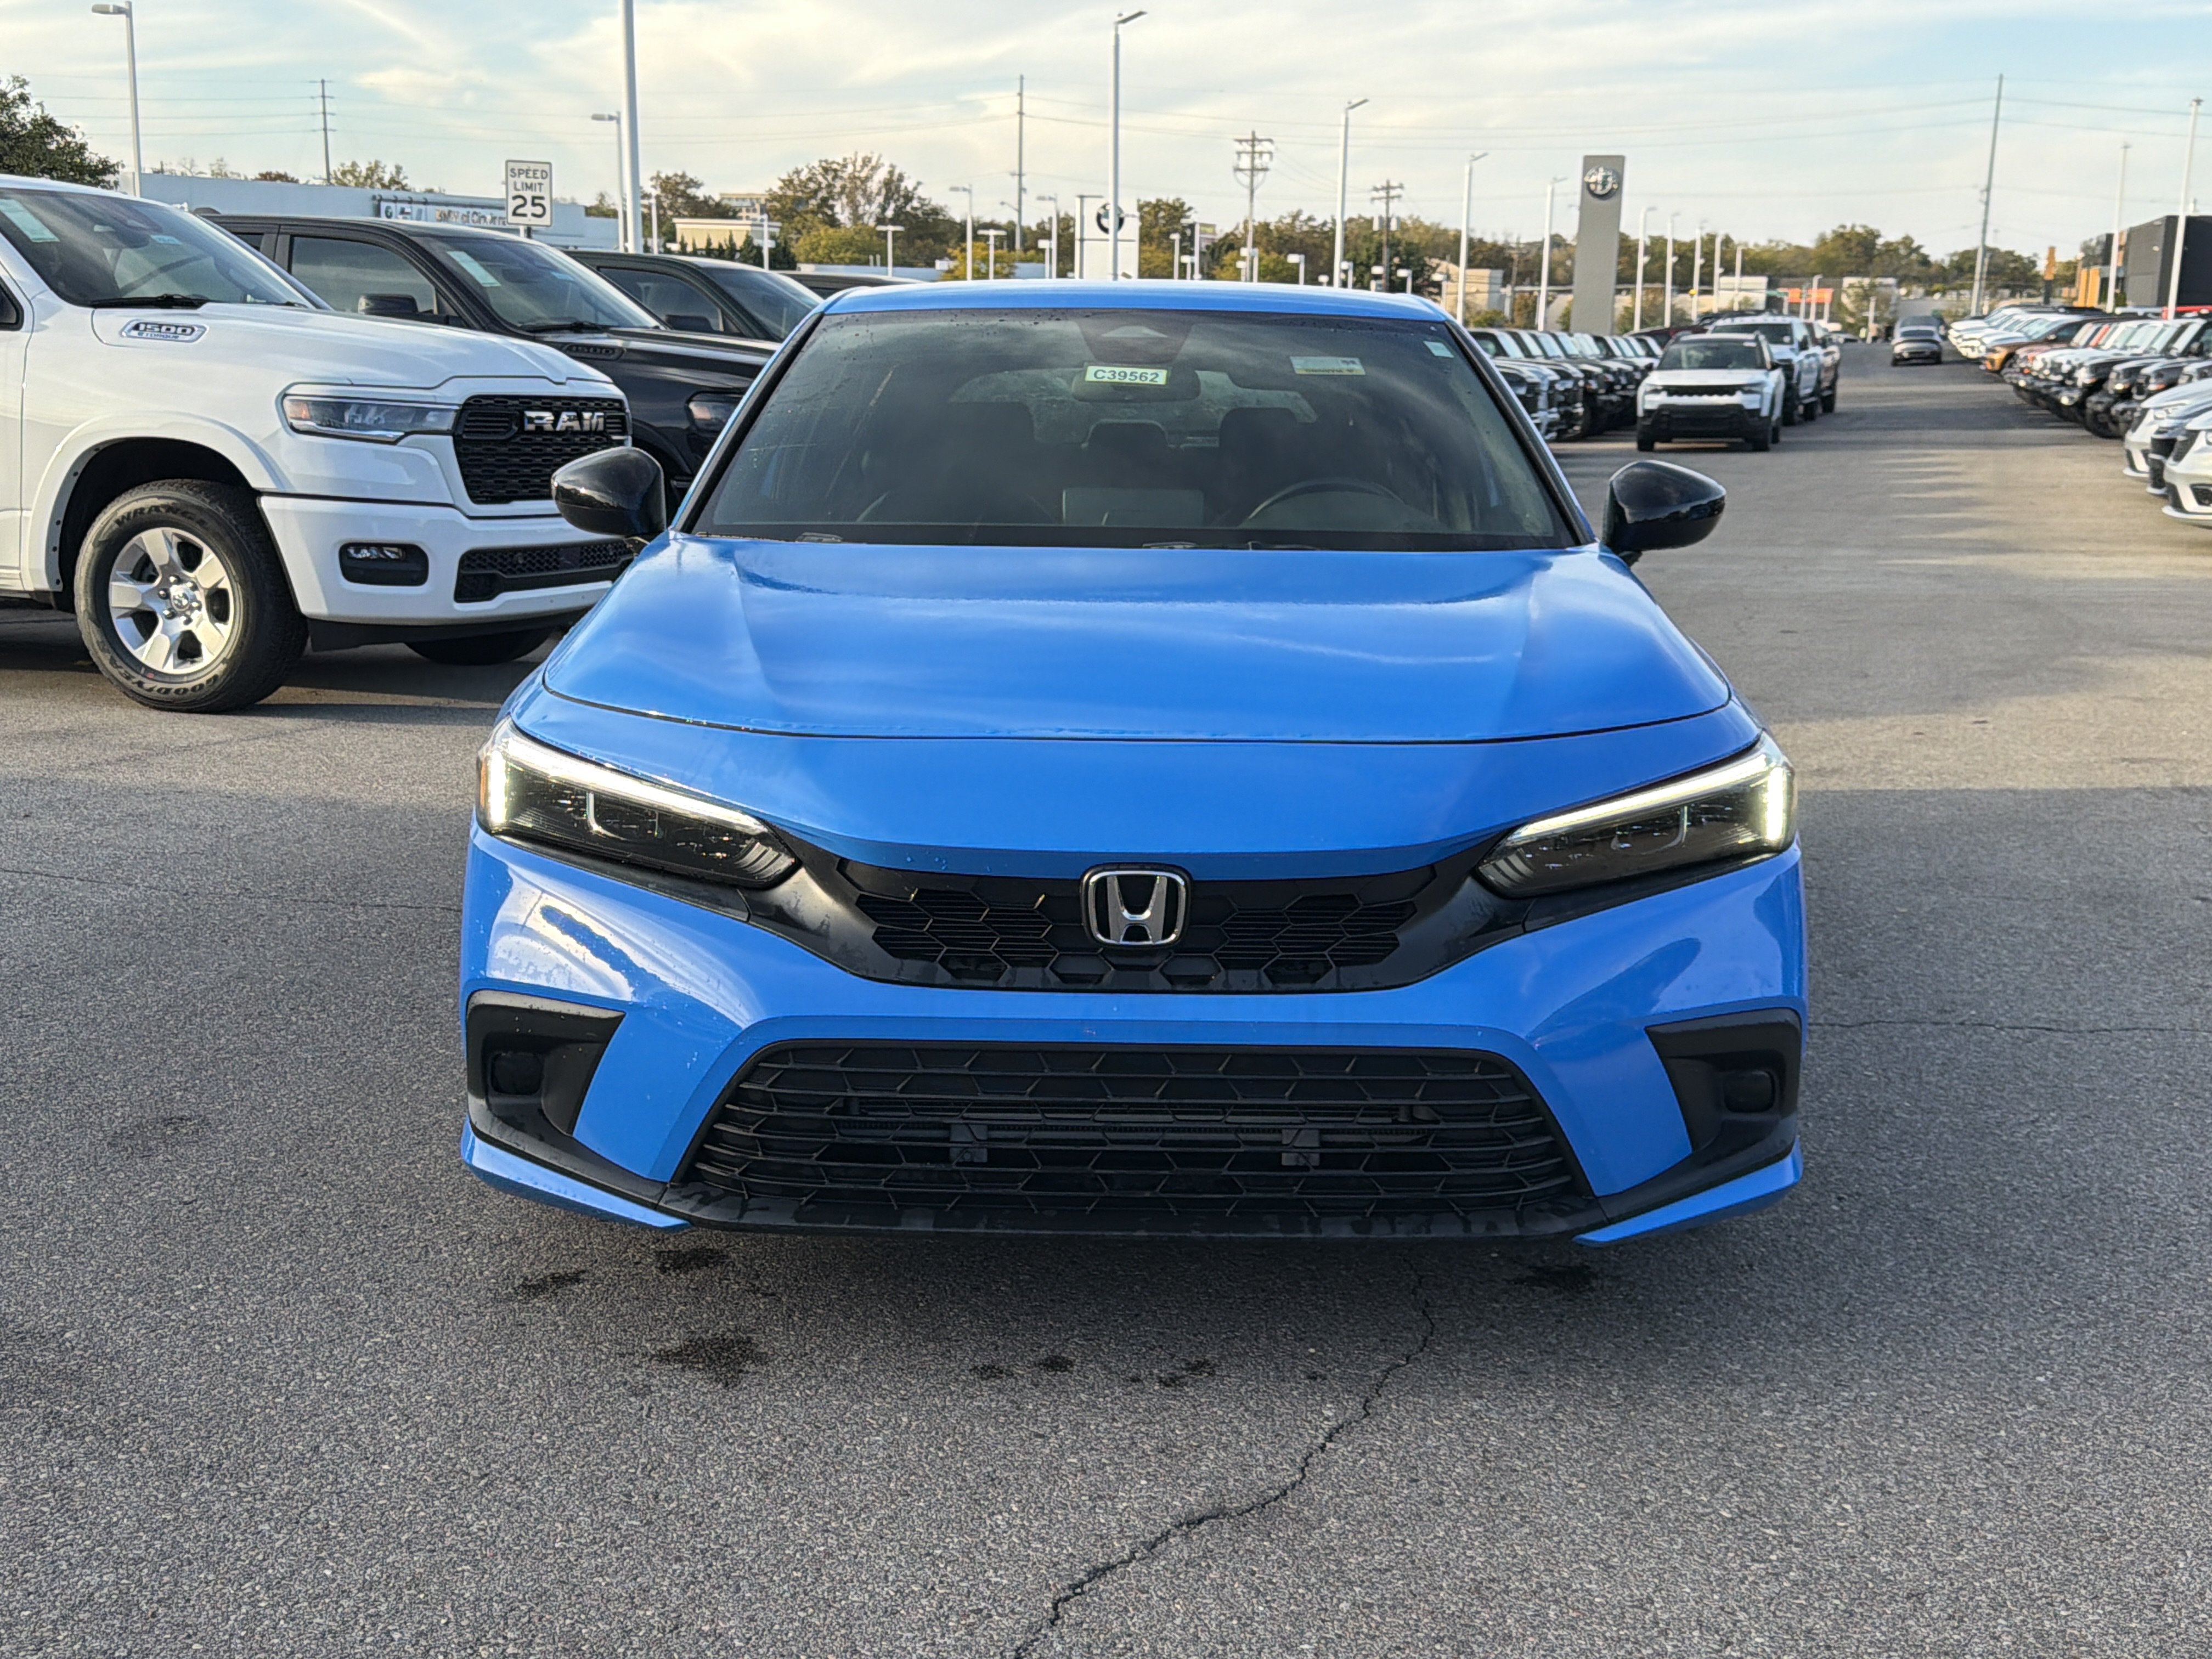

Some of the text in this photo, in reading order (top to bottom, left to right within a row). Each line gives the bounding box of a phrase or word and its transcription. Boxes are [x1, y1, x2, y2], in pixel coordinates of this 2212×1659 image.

[510, 168, 548, 179] SPEED
[514, 181, 544, 193] LIMIT
[512, 195, 546, 218] 25
[139, 323, 192, 334] 1500
[1093, 369, 1159, 383] C39562
[524, 410, 605, 431] RAM
